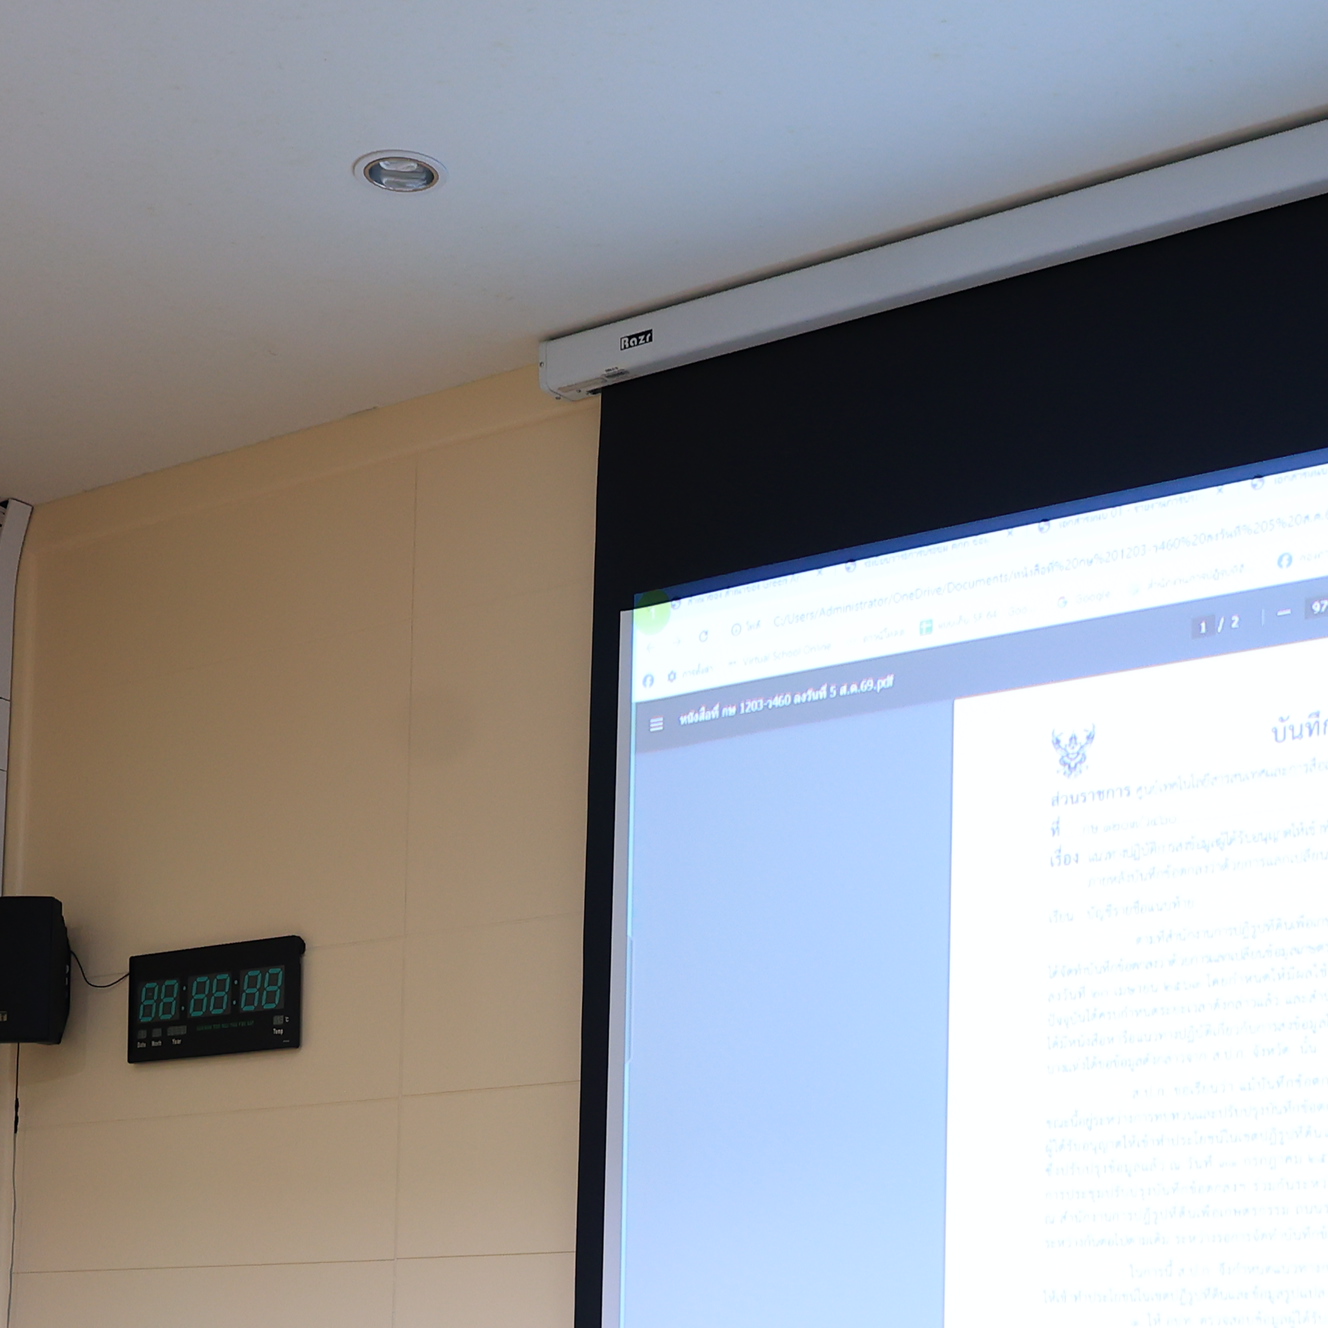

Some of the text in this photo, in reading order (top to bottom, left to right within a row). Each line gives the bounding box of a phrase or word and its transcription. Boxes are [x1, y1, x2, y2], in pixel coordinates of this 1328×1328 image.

[621, 330, 653, 349] Razr
[1074, 586, 1111, 607] Google
[1198, 619, 1207, 634] 1
[1230, 613, 1240, 629] 2
[828, 683, 837, 699] 5
[1050, 784, 1132, 808] ส่วนราชการ
[1049, 815, 1062, 839] ที่
[1049, 845, 1081, 869] เรื่อง
